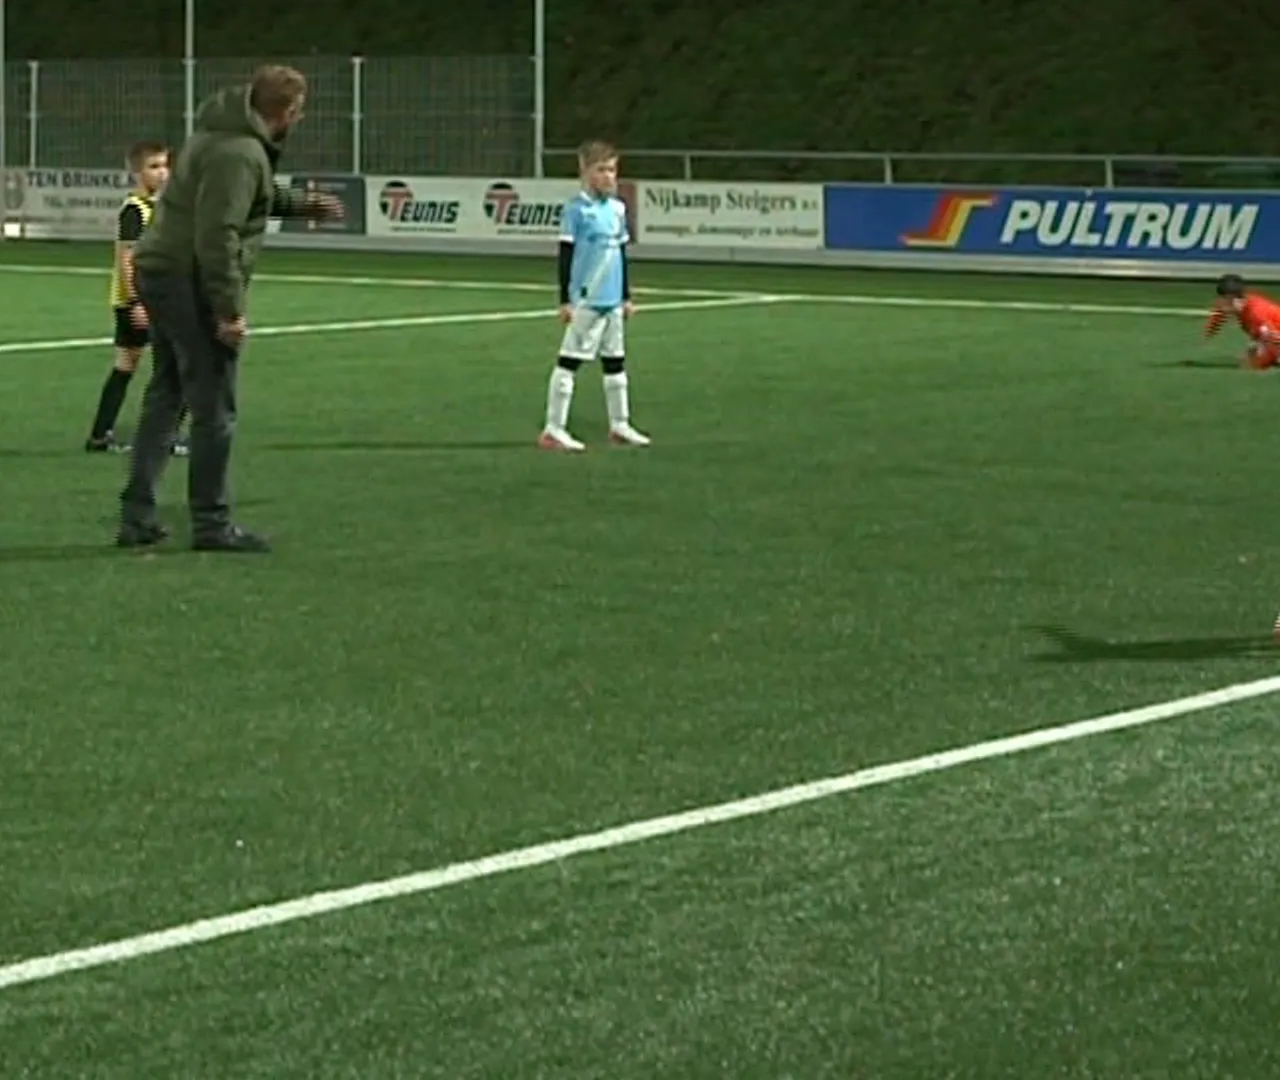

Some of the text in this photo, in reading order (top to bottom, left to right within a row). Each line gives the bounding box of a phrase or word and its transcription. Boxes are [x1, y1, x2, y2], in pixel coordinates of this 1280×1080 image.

[381, 187, 460, 224] TEUNIS
[644, 187, 721, 215] Nijkamp
[725, 189, 797, 215] Steigers
[999, 199, 1260, 251] PULTRUM
